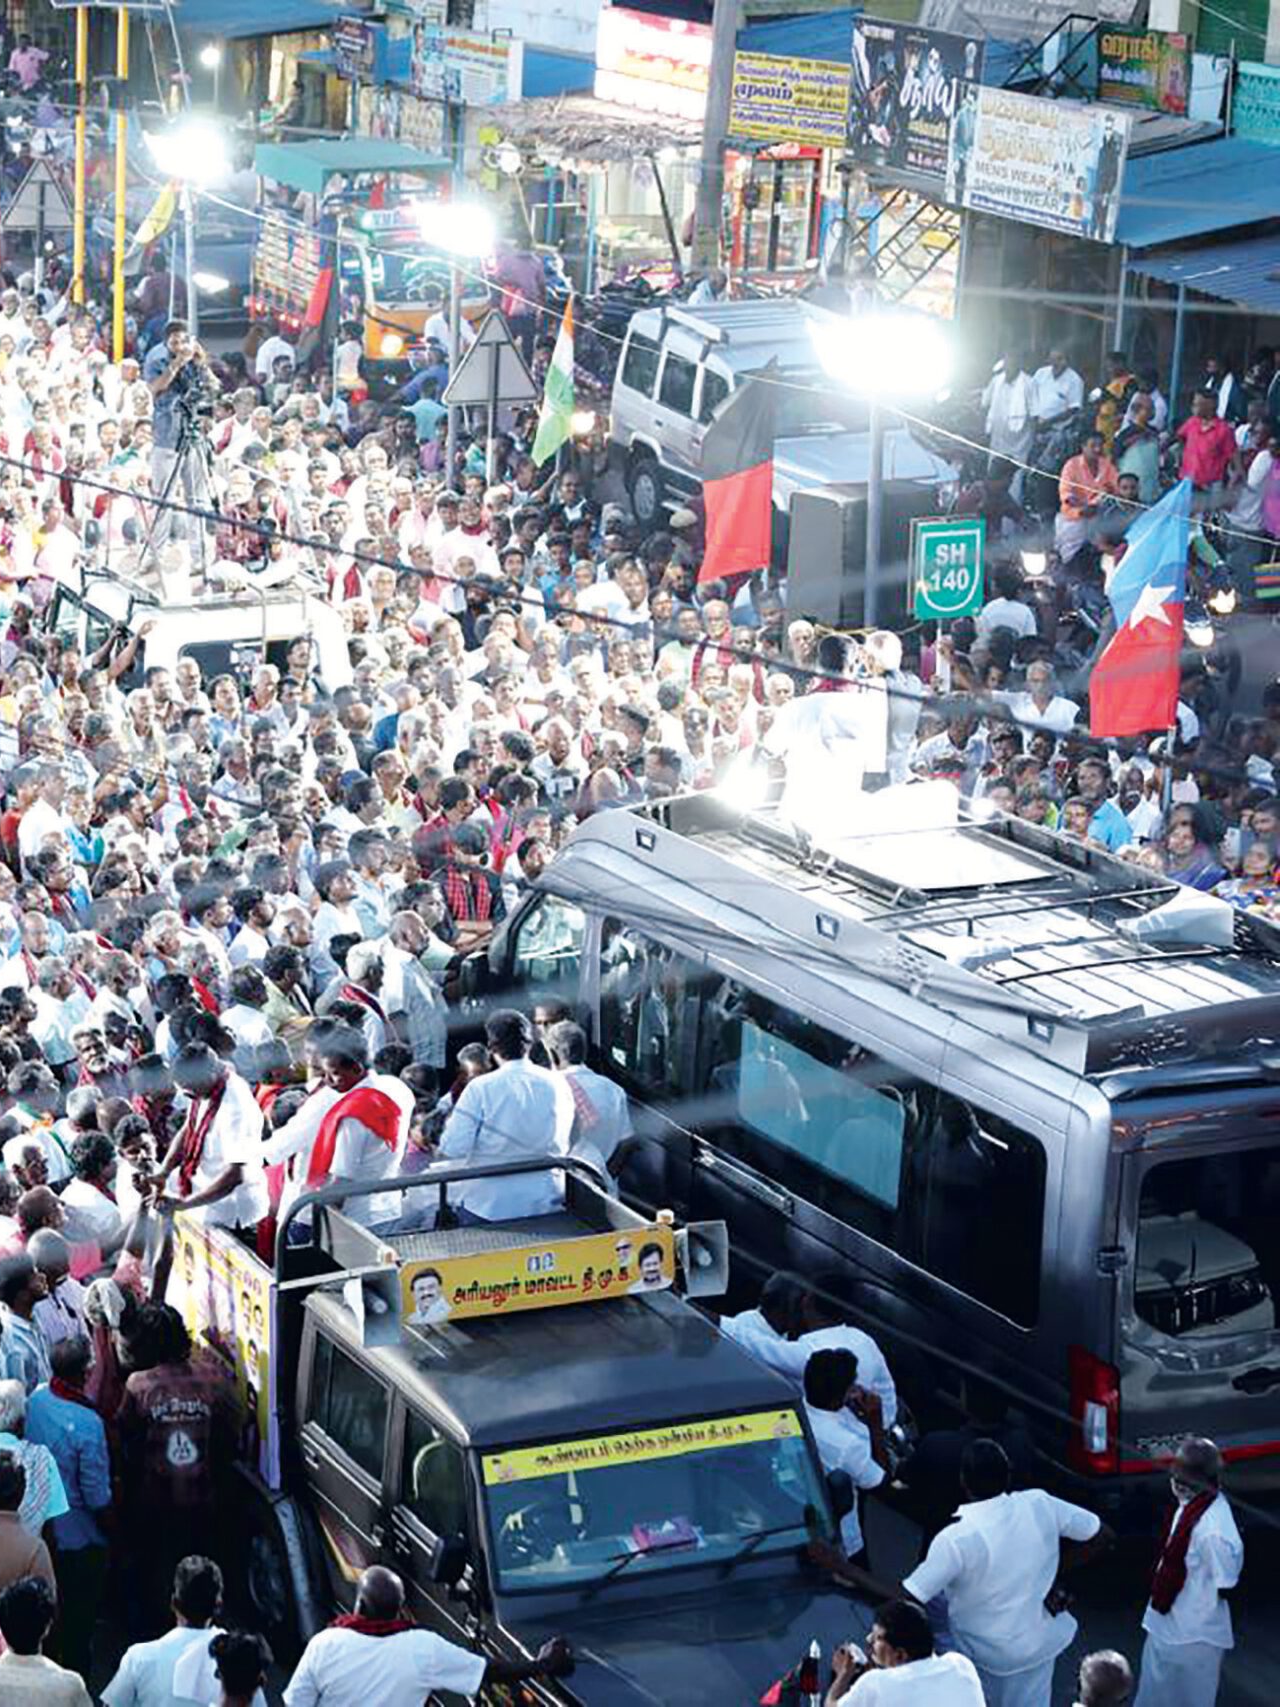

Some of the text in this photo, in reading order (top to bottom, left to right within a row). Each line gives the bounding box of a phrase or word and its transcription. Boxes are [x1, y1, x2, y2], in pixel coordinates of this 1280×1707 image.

[1010, 168, 1048, 188] WEAR
[1022, 188, 1060, 212] WEAR
[935, 542, 966, 566] SH
[930, 567, 969, 591] 140
[452, 1276, 521, 1307] அரியலூர்
[524, 1275, 578, 1296] மாவட்ட
